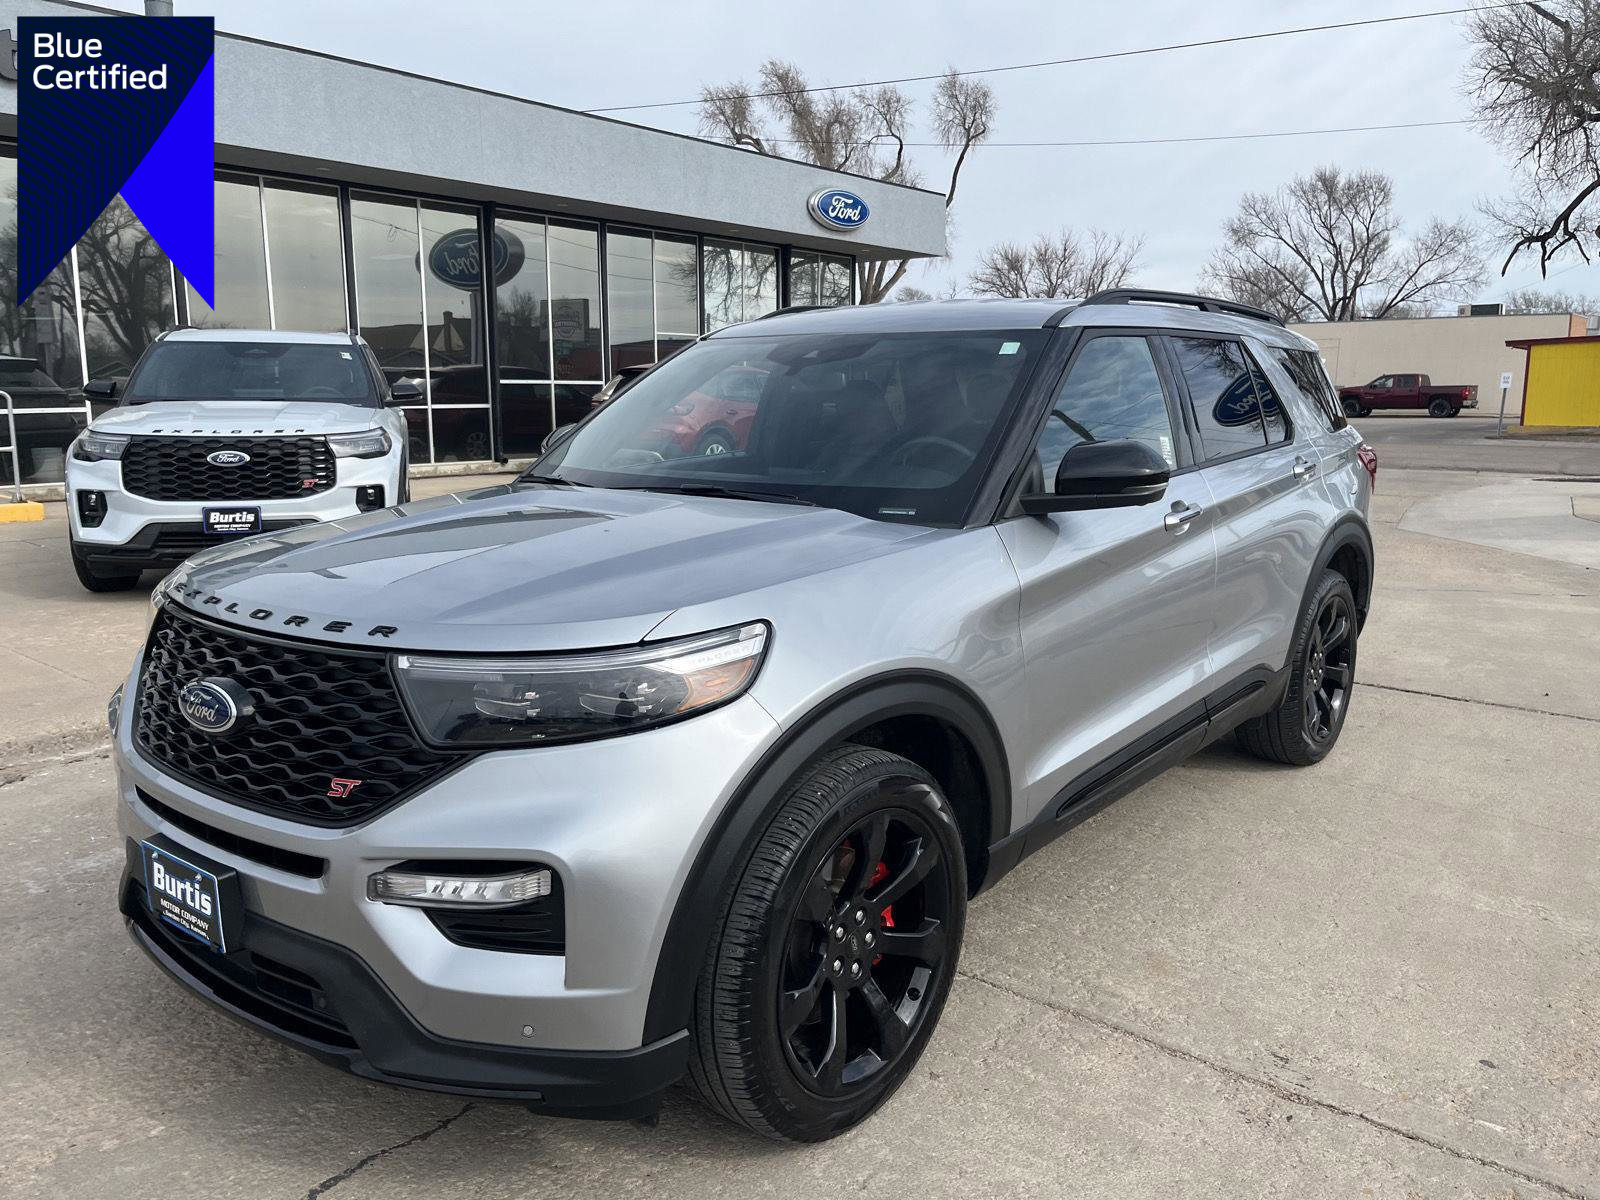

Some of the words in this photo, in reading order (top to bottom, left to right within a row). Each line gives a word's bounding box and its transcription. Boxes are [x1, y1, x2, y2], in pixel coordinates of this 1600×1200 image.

[828, 195, 862, 221] Ford
[215, 453, 240, 464] Ford
[302, 479, 319, 488] ST
[210, 511, 255, 523] Burtis
[174, 582, 399, 638] EXPLORER
[186, 690, 220, 723] Ford
[326, 777, 362, 798] ST
[153, 861, 212, 917] Burtis
[160, 898, 181, 915] MOTOR
[181, 909, 209, 931] COMPANY
